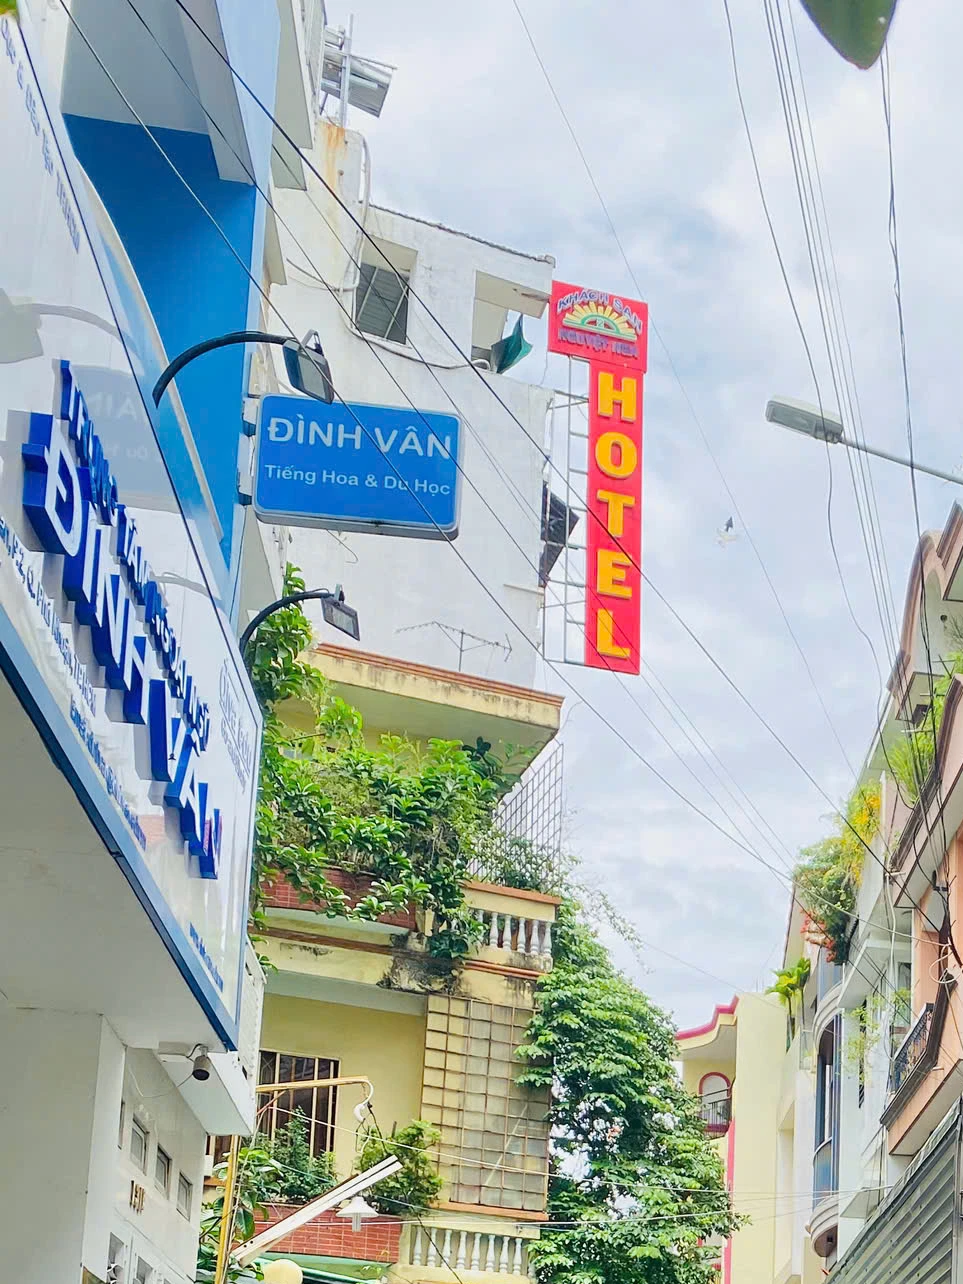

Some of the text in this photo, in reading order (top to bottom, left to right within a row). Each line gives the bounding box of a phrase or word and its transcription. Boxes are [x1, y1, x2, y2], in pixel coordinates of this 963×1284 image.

[264, 463, 452, 498] Tiếng Hoa & Du Học
[267, 413, 451, 460] ĐÌNH VÂN
[594, 370, 639, 661] HOTEL
[22, 412, 150, 725] ĐÌNH
[149, 680, 223, 880] VÂN
